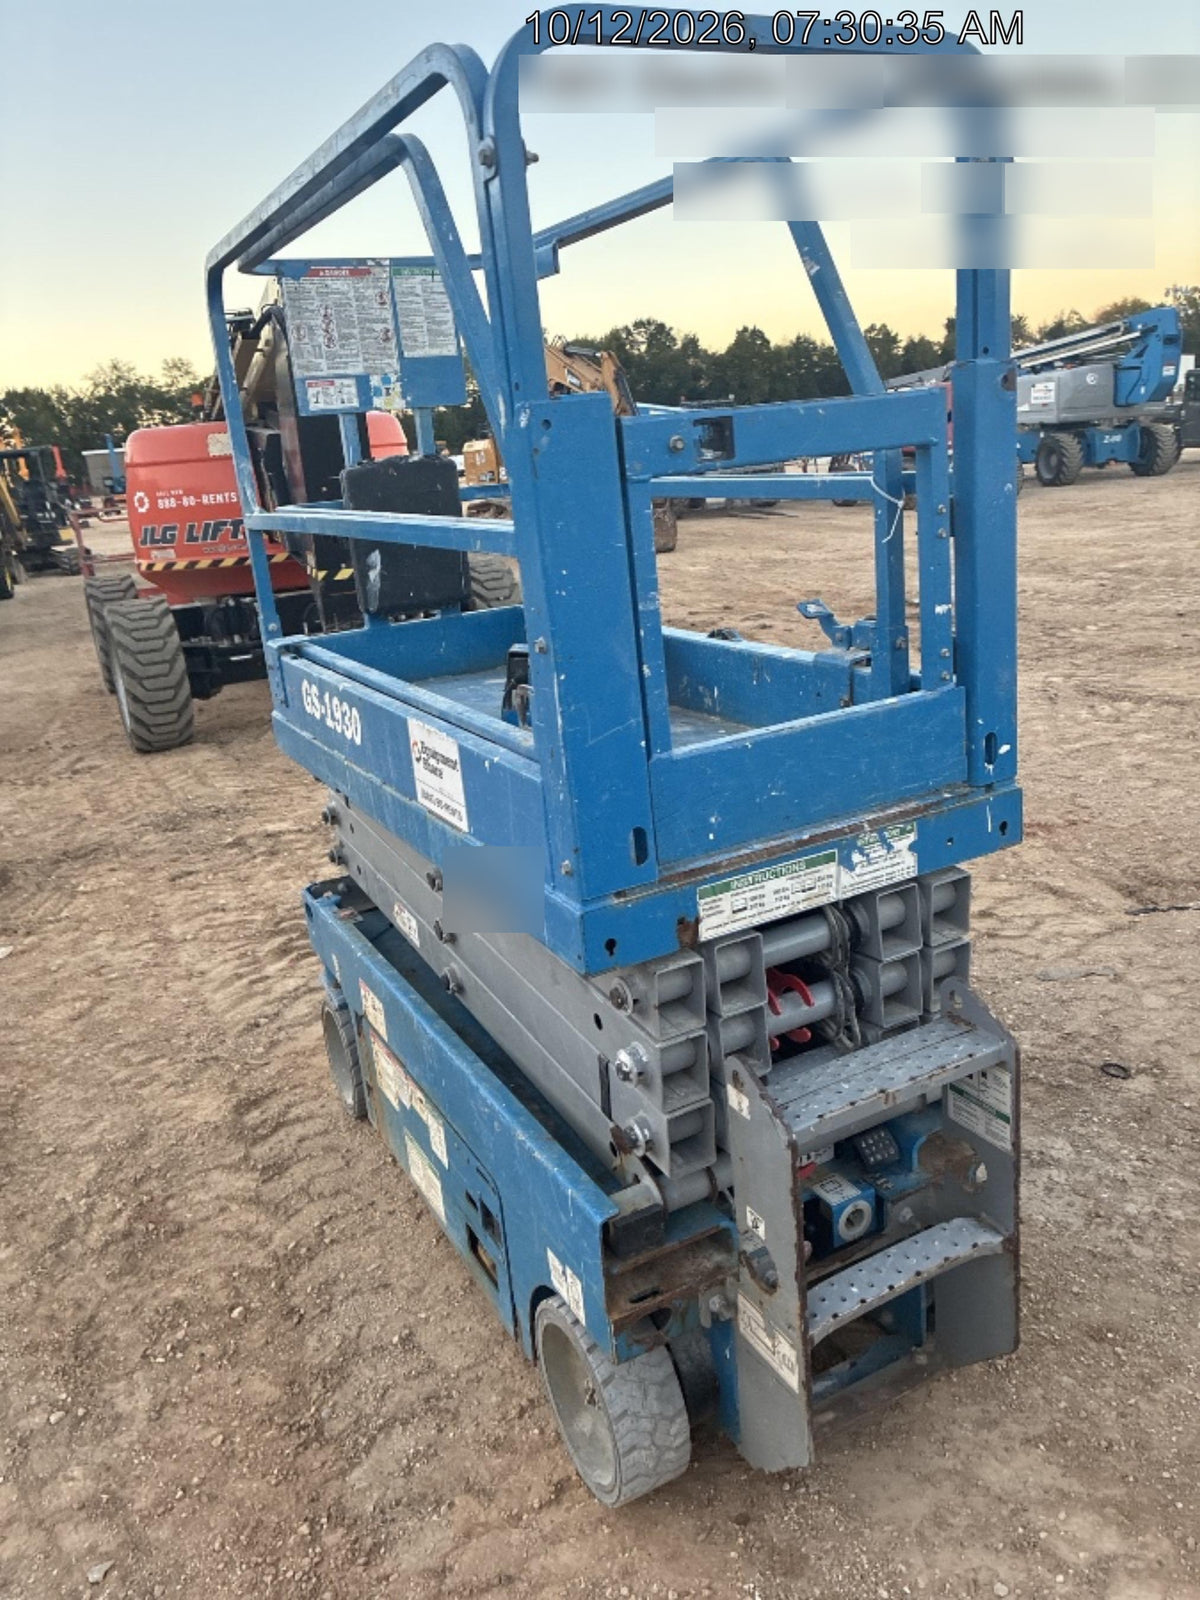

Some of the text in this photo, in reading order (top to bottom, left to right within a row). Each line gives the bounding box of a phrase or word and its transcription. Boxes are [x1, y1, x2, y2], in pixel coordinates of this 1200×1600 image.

[140, 523, 180, 549] JLG
[183, 517, 248, 545] LIFT
[301, 678, 362, 746] GS-1930
